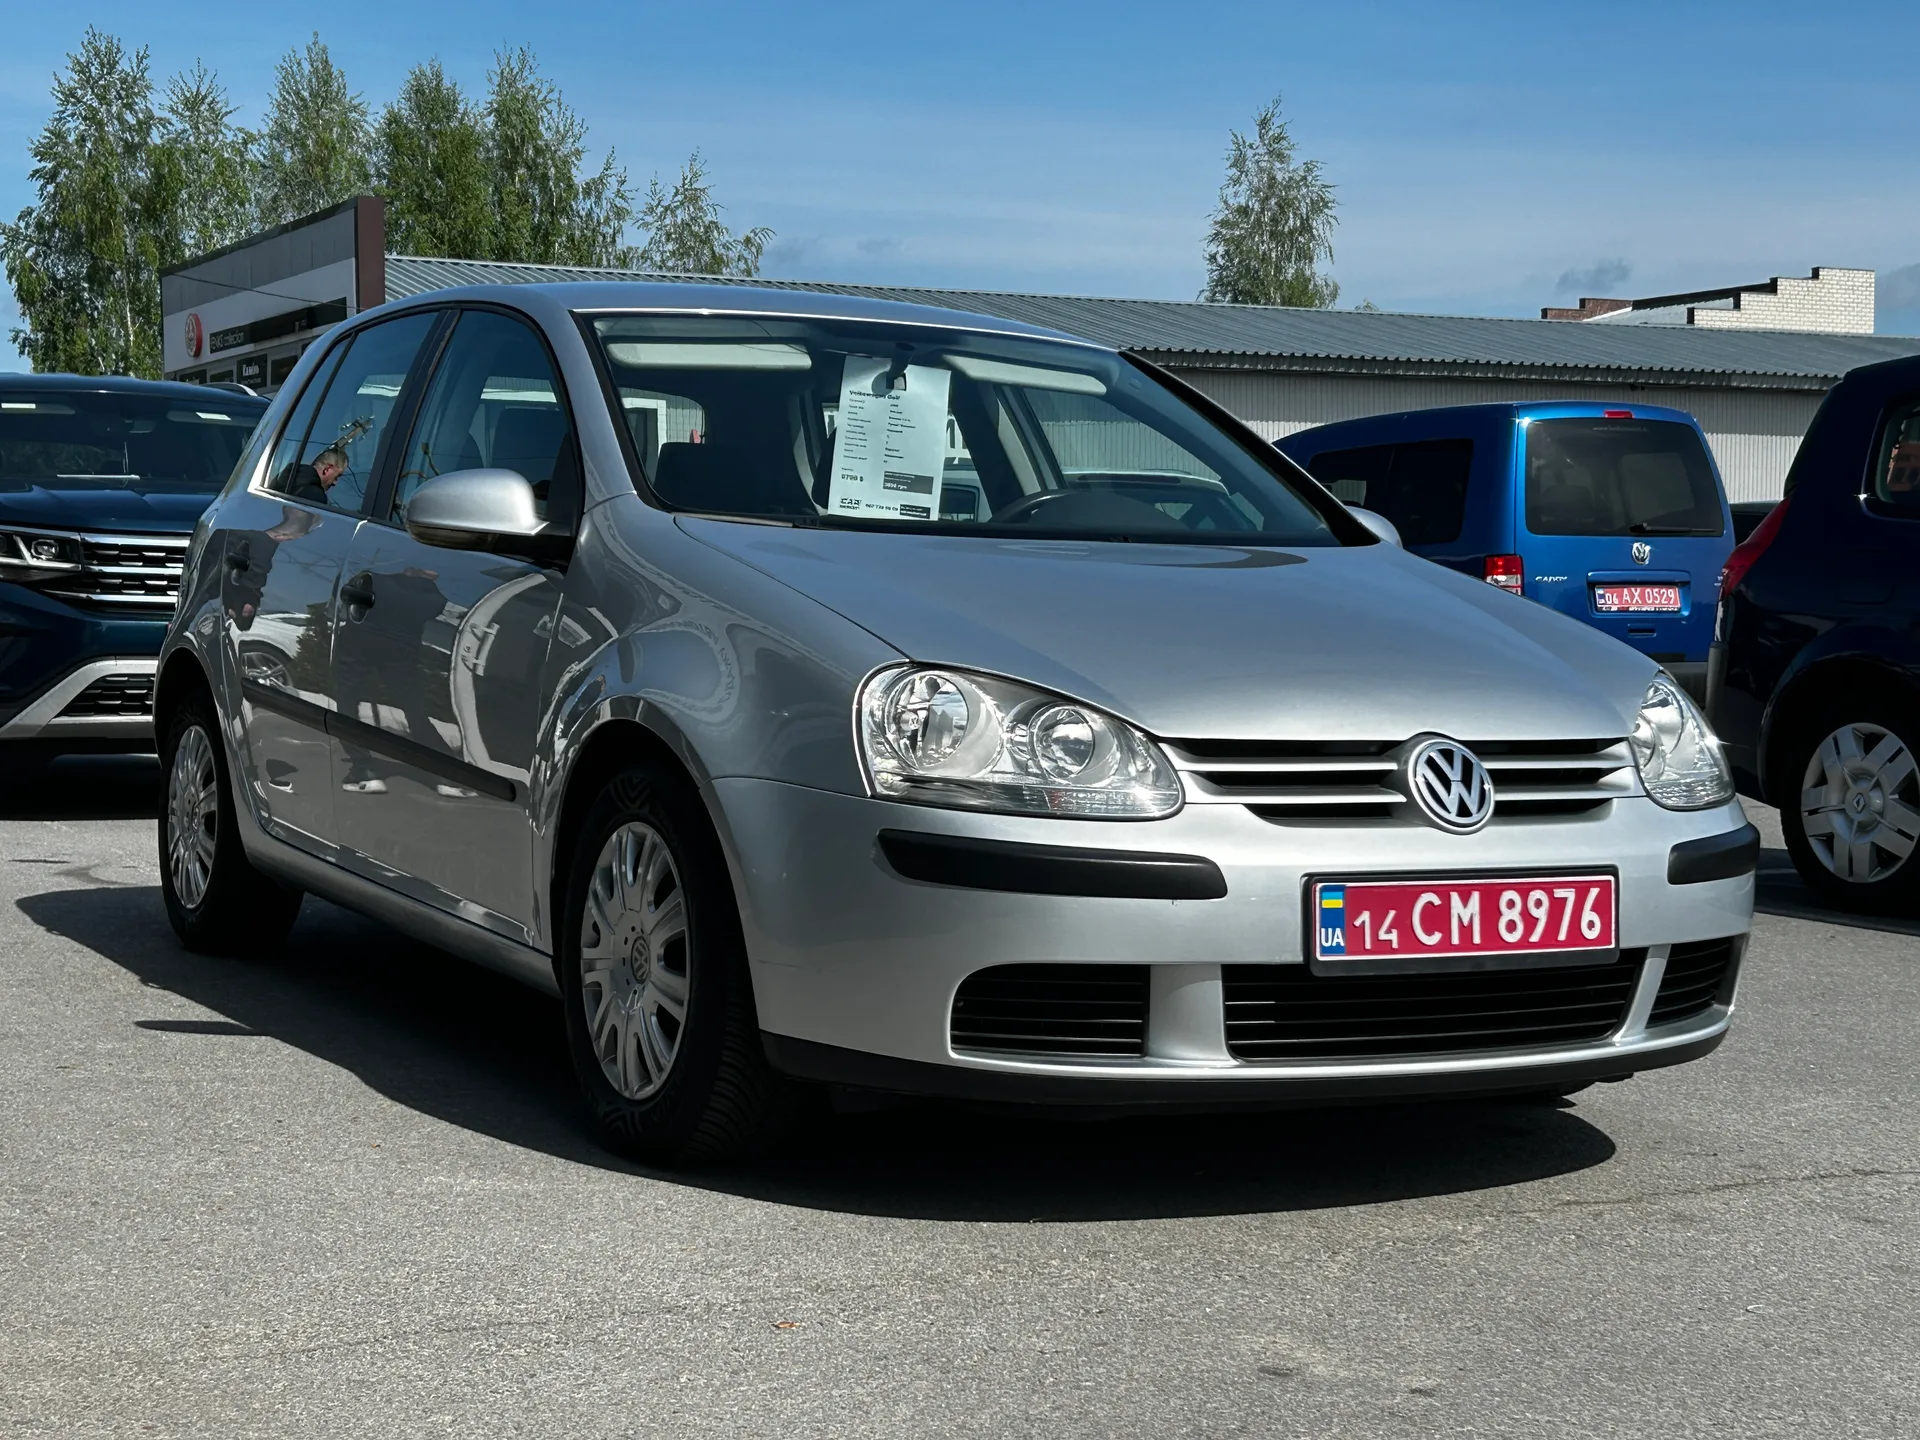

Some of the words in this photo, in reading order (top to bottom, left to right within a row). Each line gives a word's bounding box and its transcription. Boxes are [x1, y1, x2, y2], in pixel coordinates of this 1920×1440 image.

[1605, 592, 1618, 605] 06
[1623, 587, 1642, 604] AX
[1645, 588, 1675, 604] 0529
[1353, 910, 1398, 950] 14
[1412, 890, 1480, 946] CM
[1498, 887, 1601, 943] 8976
[1321, 927, 1345, 947] UA
